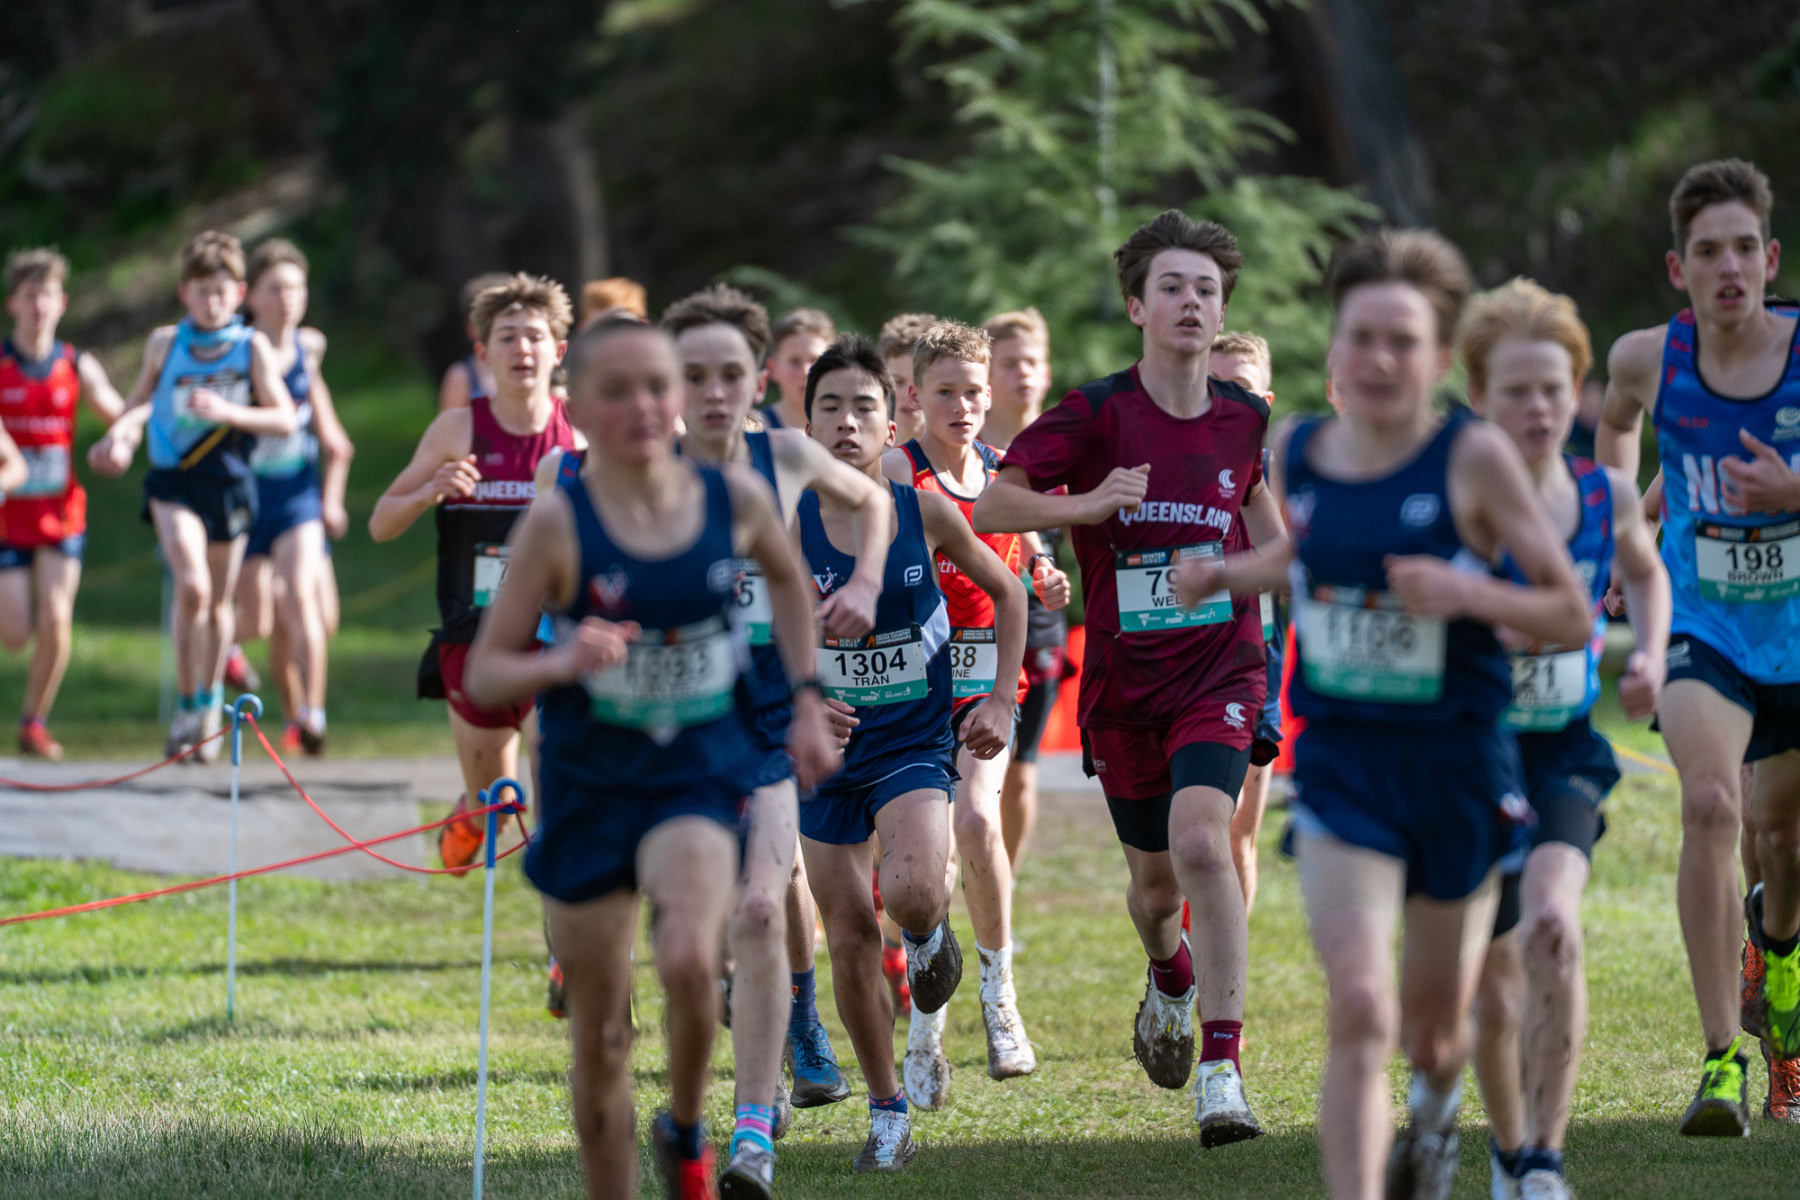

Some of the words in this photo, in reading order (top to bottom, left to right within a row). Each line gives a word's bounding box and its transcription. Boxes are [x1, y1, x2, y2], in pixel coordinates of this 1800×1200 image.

[1119, 501, 1232, 534] QUEENSLAND
[1725, 544, 1783, 571] 198
[834, 648, 907, 677] 1304
[852, 675, 890, 687] TRAN
